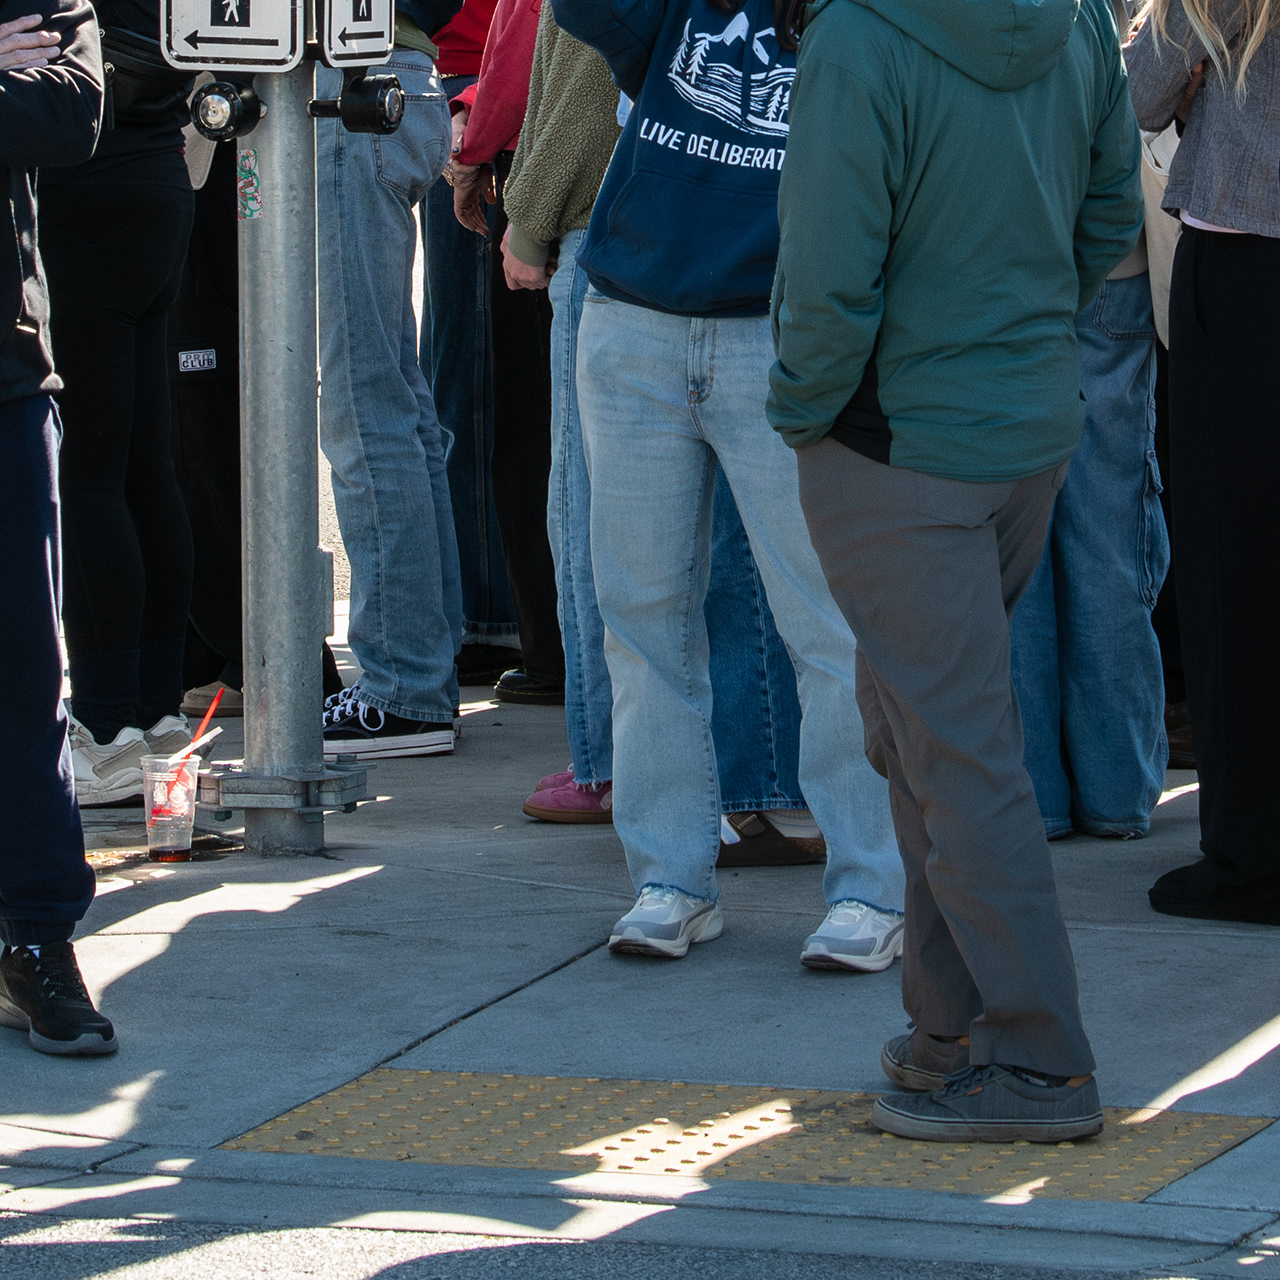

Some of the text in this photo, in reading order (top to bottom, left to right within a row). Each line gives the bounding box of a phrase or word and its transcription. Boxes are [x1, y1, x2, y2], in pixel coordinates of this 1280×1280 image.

[639, 118, 685, 152] LIVE
[185, 352, 210, 361] PRO
[182, 359, 214, 368] CLUB
